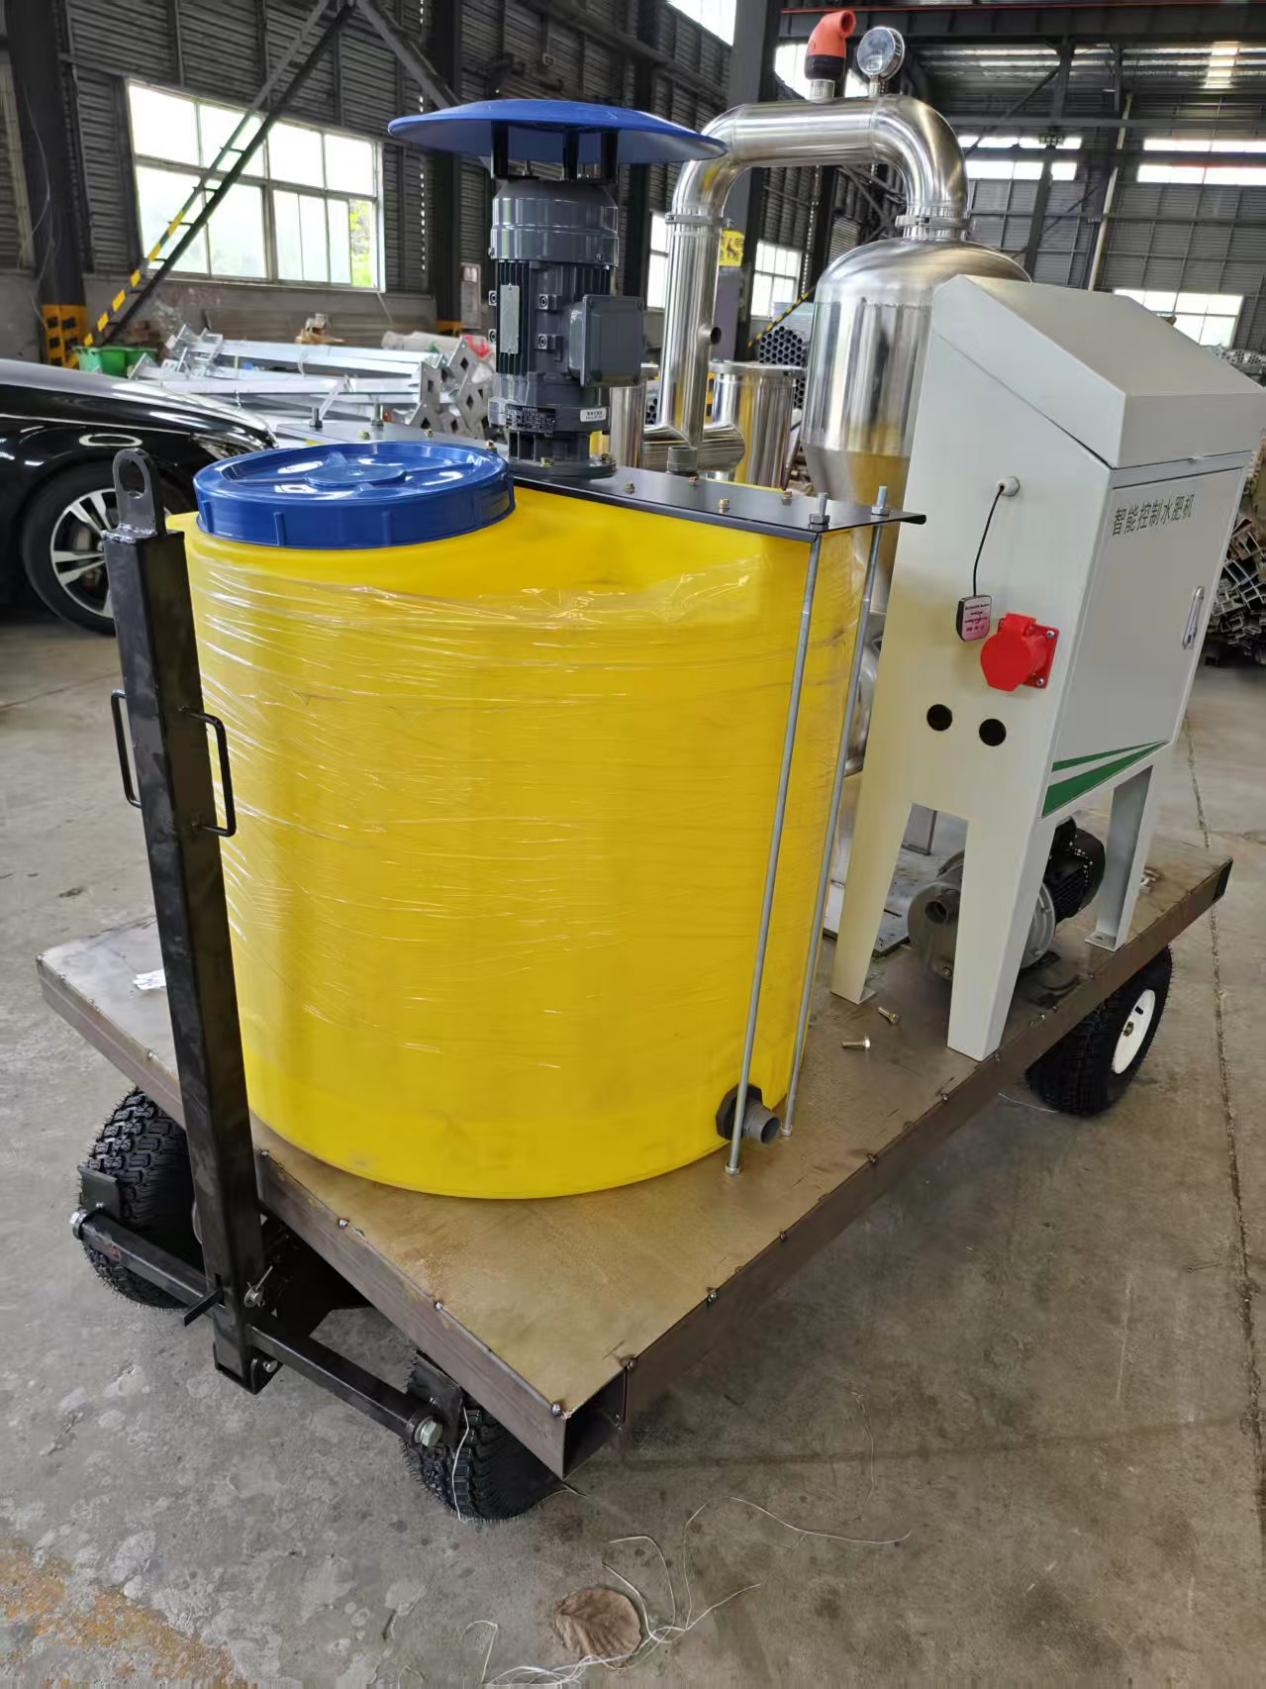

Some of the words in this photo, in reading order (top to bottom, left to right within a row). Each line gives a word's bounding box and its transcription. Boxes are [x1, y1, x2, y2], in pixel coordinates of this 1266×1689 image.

[1112, 494, 1195, 536] 智能控制水肥机
